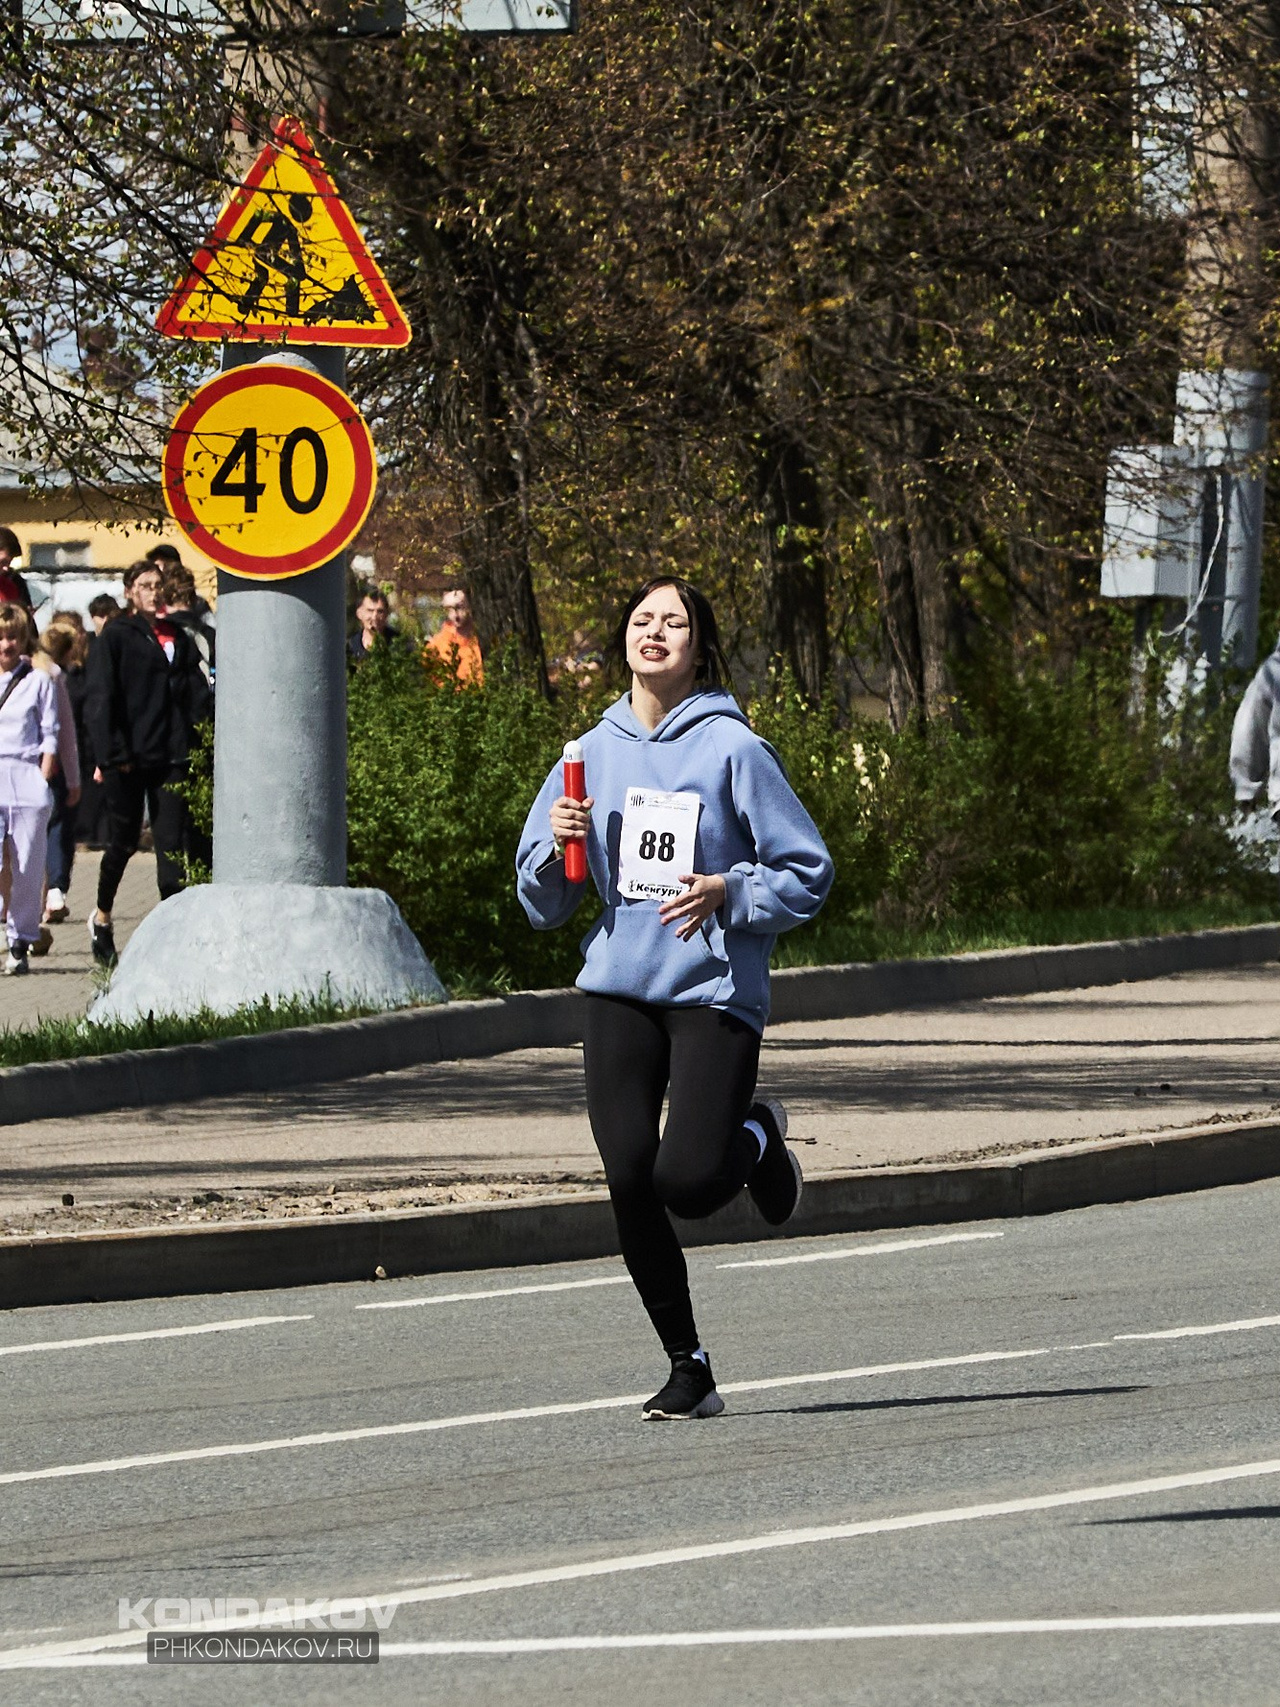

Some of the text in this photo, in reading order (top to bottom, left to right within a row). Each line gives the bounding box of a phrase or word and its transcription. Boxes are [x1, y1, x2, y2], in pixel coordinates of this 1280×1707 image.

[210, 426, 328, 514] 40
[639, 830, 675, 862] 88
[636, 883, 682, 896] Кенгуру
